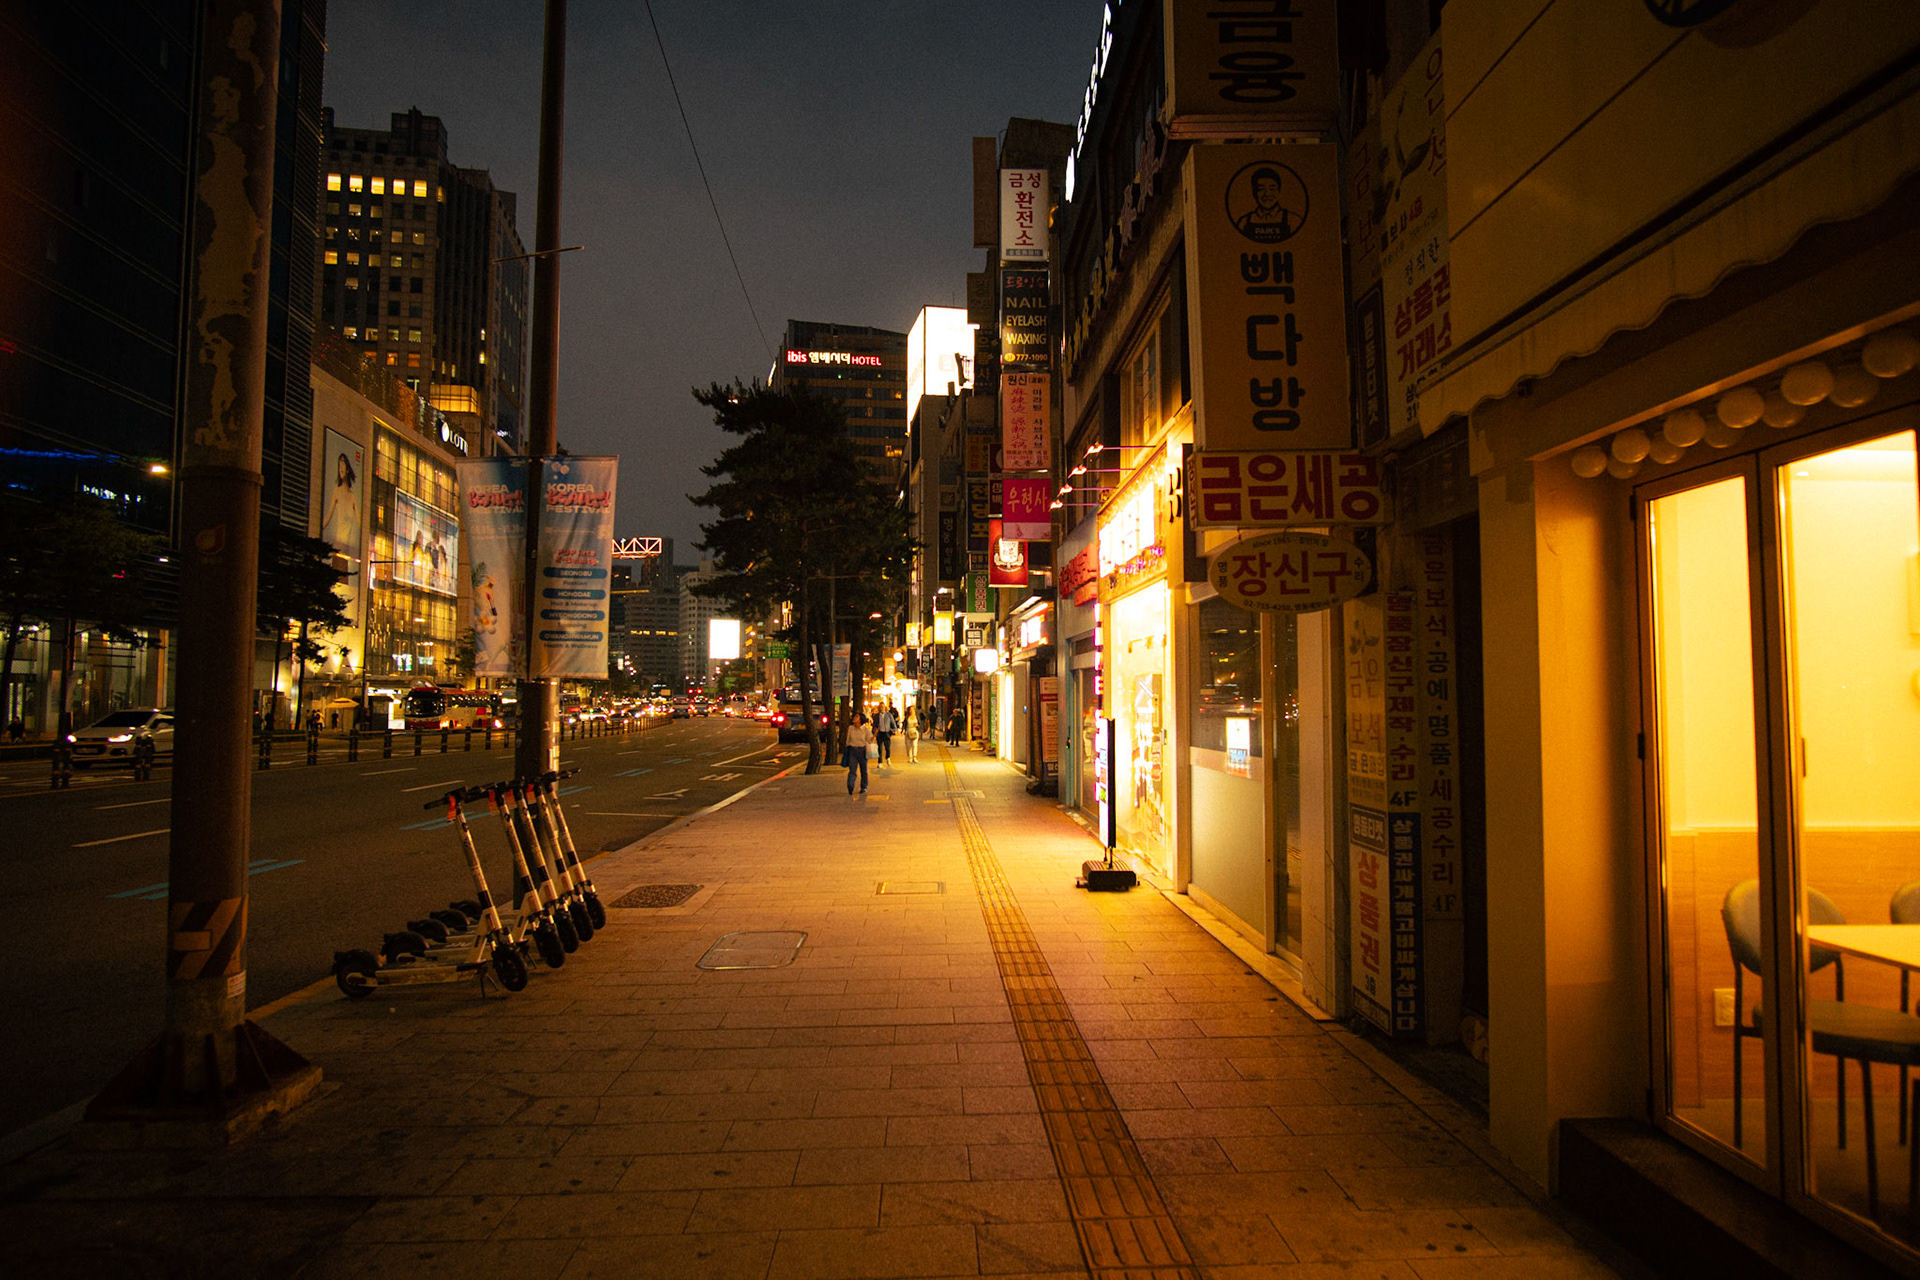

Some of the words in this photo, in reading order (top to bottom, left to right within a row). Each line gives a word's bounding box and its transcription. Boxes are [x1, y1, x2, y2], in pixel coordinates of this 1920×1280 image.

[1008, 172, 1042, 188] 금성
[1014, 191, 1035, 247] 환전소
[1005, 296, 1047, 309] NAIL
[1395, 262, 1450, 341] 상품권
[1005, 314, 1047, 328] EYELASH
[1005, 332, 1047, 346] WAXING
[1240, 251, 1306, 432] 백다방
[1396, 311, 1451, 383] 거래소
[786, 350, 807, 363] ibis
[851, 355, 882, 367] HOTEL
[1007, 375, 1028, 386] 원신
[546, 482, 595, 493] KOREA
[1200, 454, 1381, 522] 금은세공
[545, 504, 610, 514] FESTIVAL
[1217, 561, 1228, 588] 명품
[1231, 550, 1353, 597] 장신구
[1354, 557, 1365, 582] 수리
[557, 590, 592, 598] HONGDAE
[1389, 791, 1418, 807] 4F
[1432, 894, 1456, 913] 4F
[1357, 851, 1381, 975] 상품권
